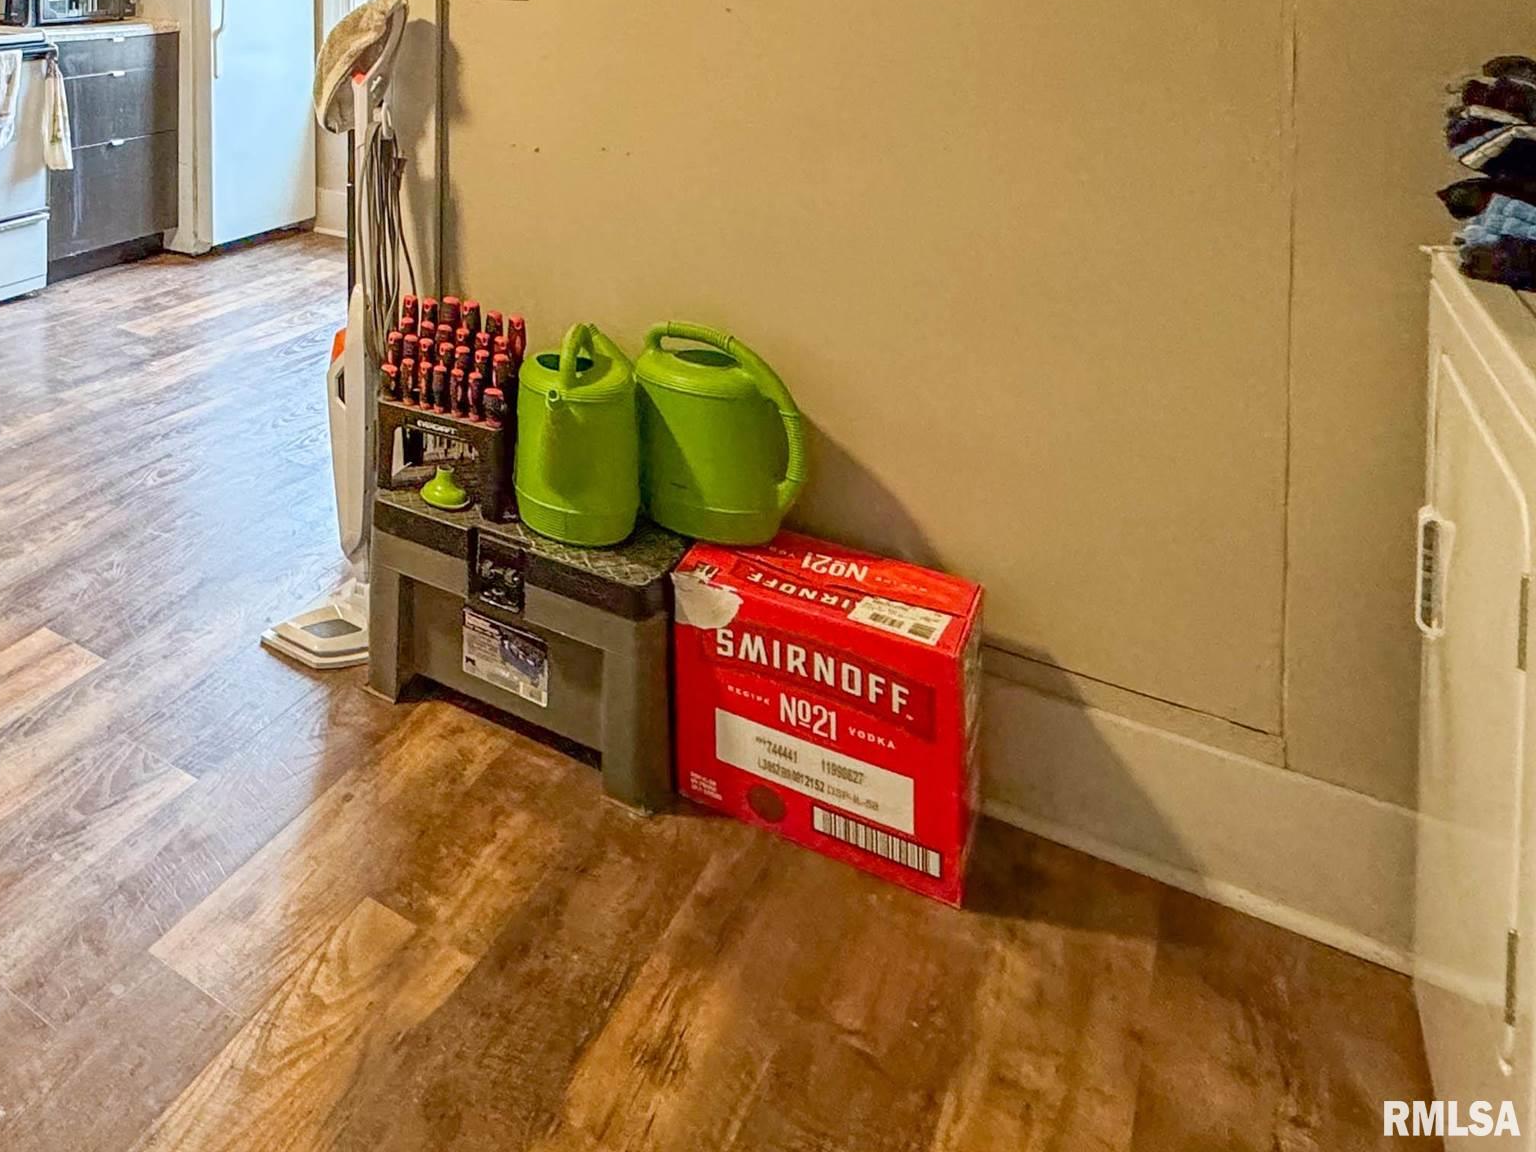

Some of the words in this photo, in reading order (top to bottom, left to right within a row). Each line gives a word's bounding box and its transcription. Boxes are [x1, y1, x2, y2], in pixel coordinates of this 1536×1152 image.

[745, 567, 855, 610] IRNOFF
[716, 628, 910, 714] SMIRNOFF
[848, 725, 897, 750] VODKA
